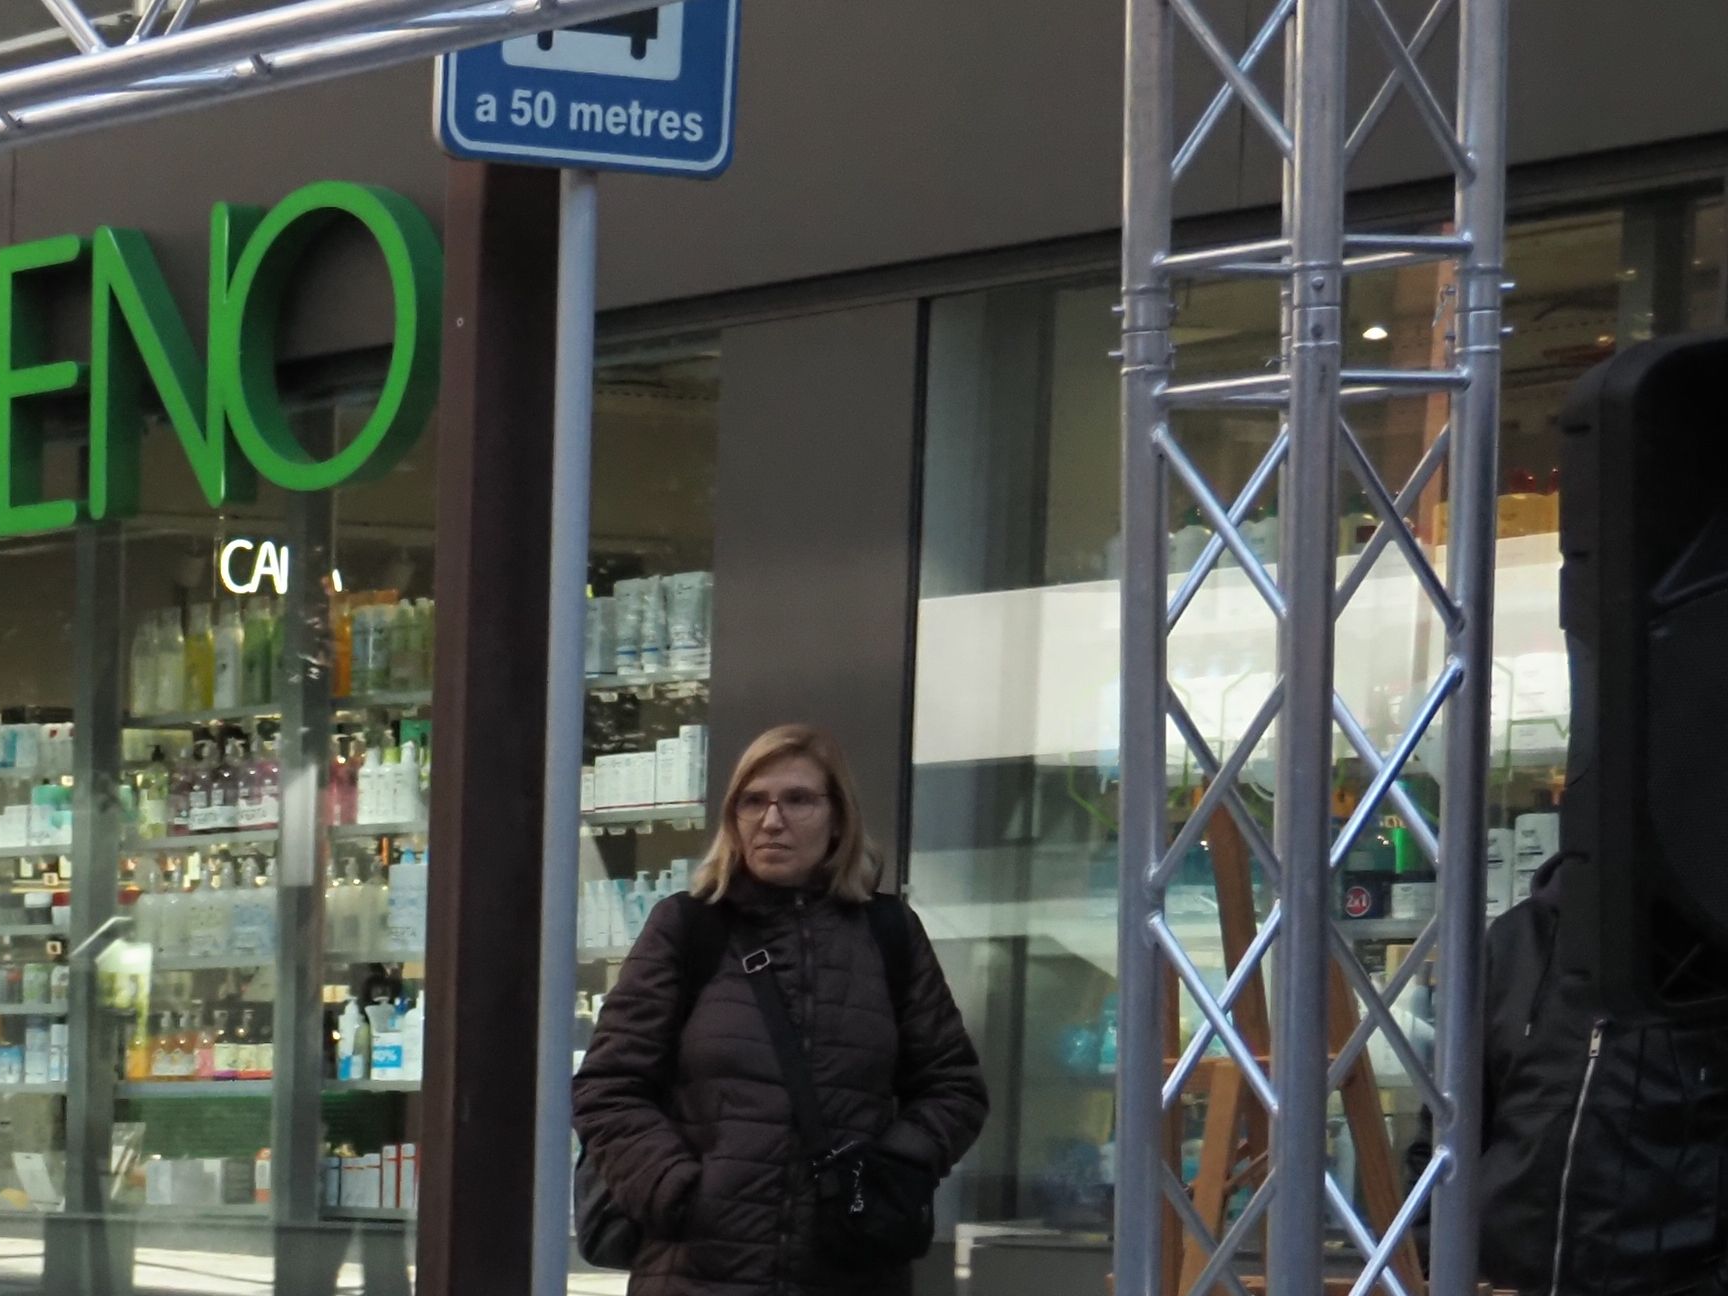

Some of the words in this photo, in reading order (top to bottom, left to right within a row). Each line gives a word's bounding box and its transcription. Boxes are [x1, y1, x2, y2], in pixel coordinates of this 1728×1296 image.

[475, 93, 497, 123] a
[510, 88, 557, 128] 50
[569, 100, 705, 142] metres
